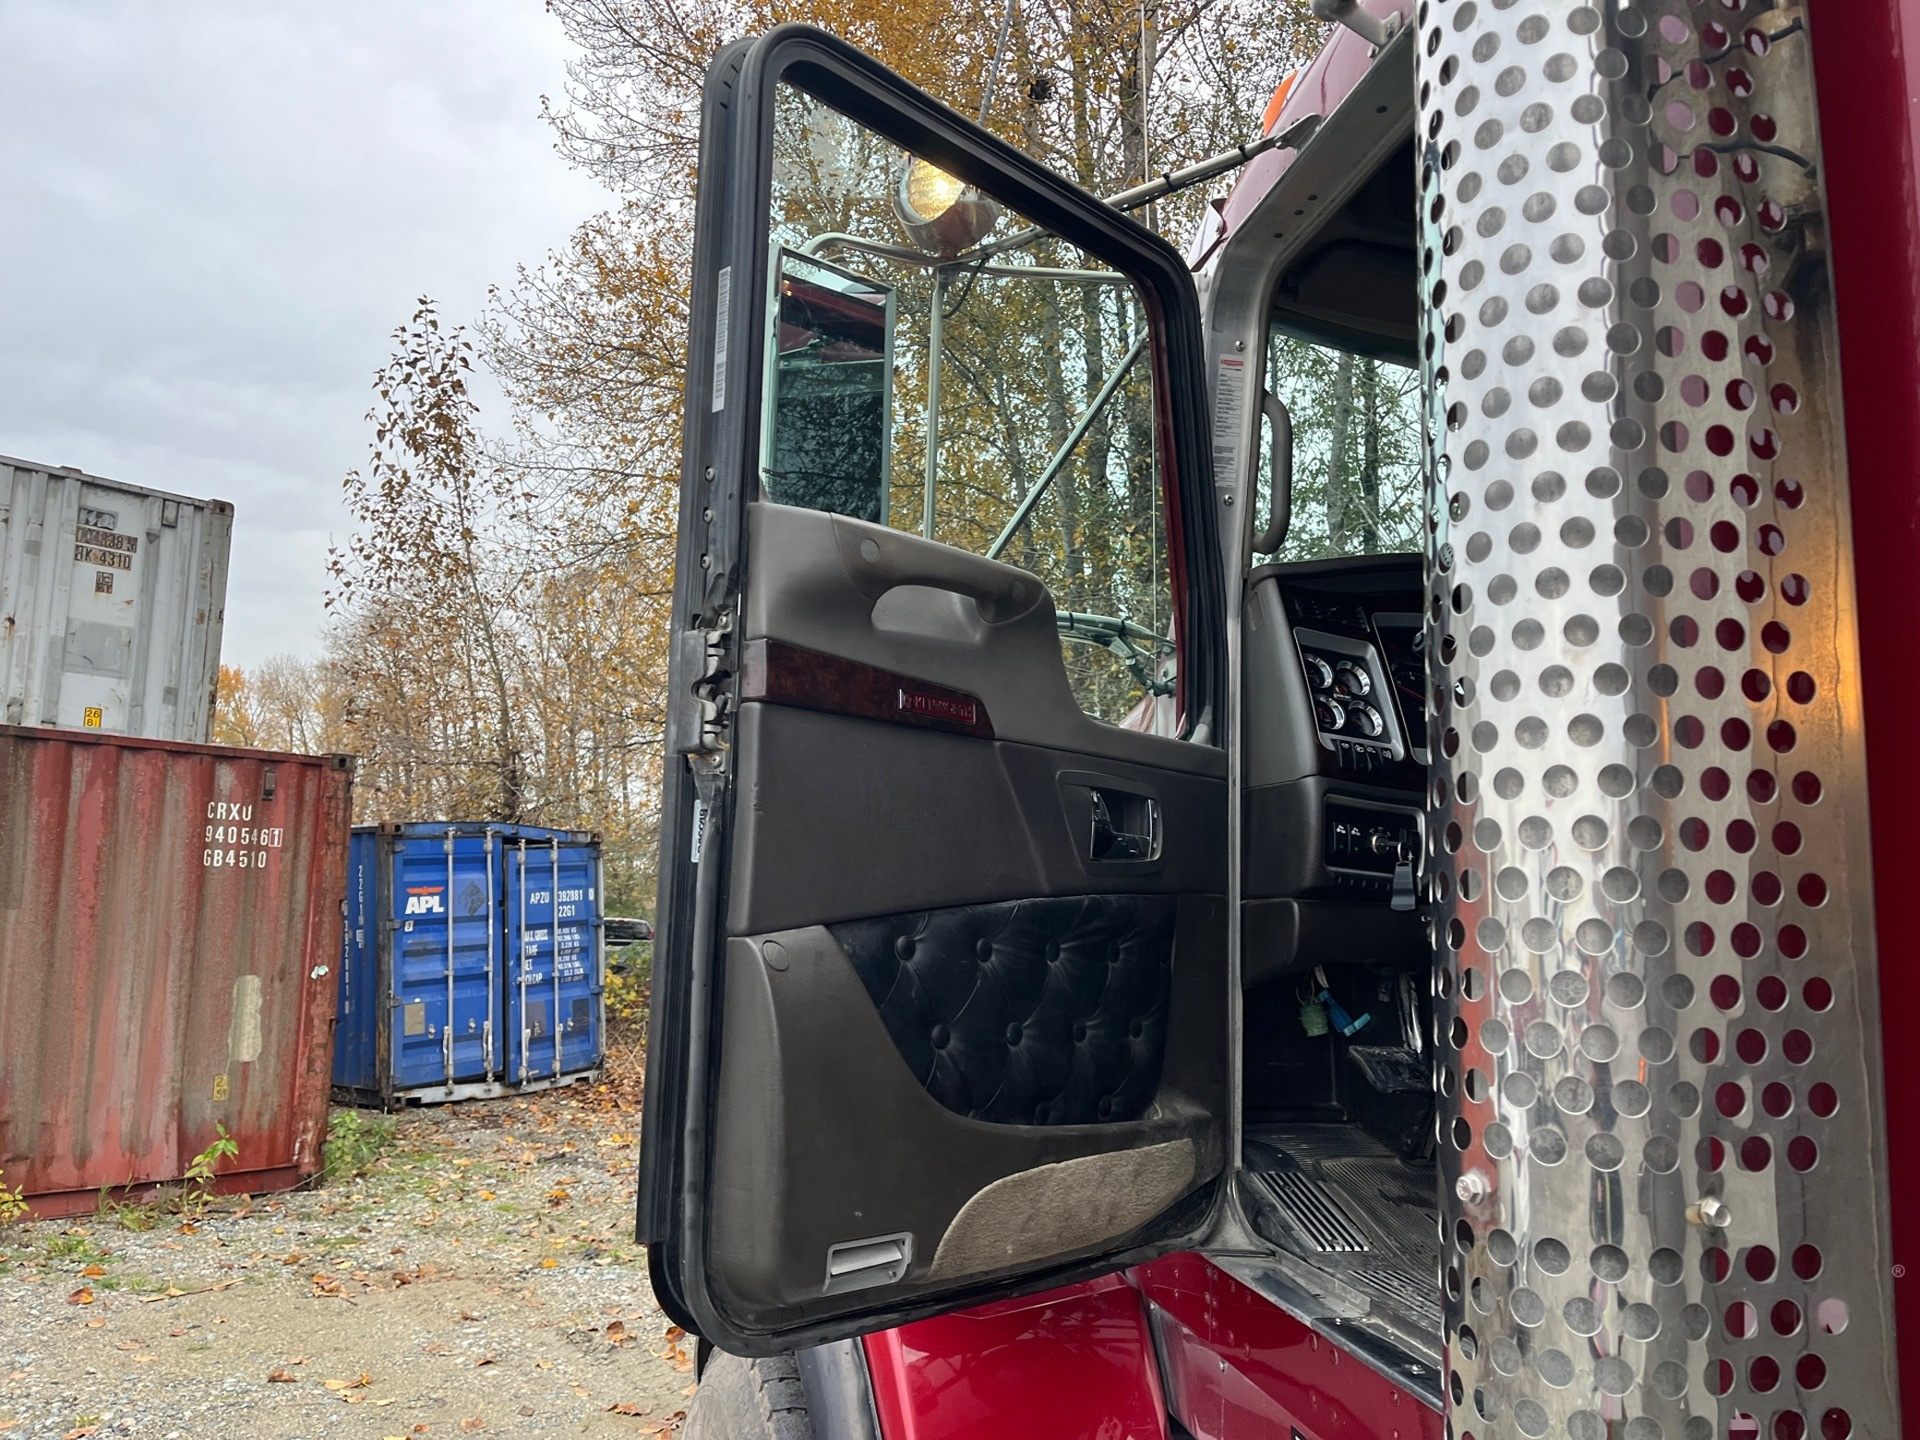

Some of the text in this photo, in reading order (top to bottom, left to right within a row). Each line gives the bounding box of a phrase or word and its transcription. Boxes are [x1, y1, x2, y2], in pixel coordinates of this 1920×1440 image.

[100, 550, 132, 570] 4310
[86, 709, 99, 718] 26
[207, 801, 252, 821] CRXU
[203, 849, 267, 868] GB4510
[405, 895, 444, 914] APL
[530, 891, 550, 904] APZU
[558, 889, 583, 902] 392881
[558, 905, 575, 917] 22G1
